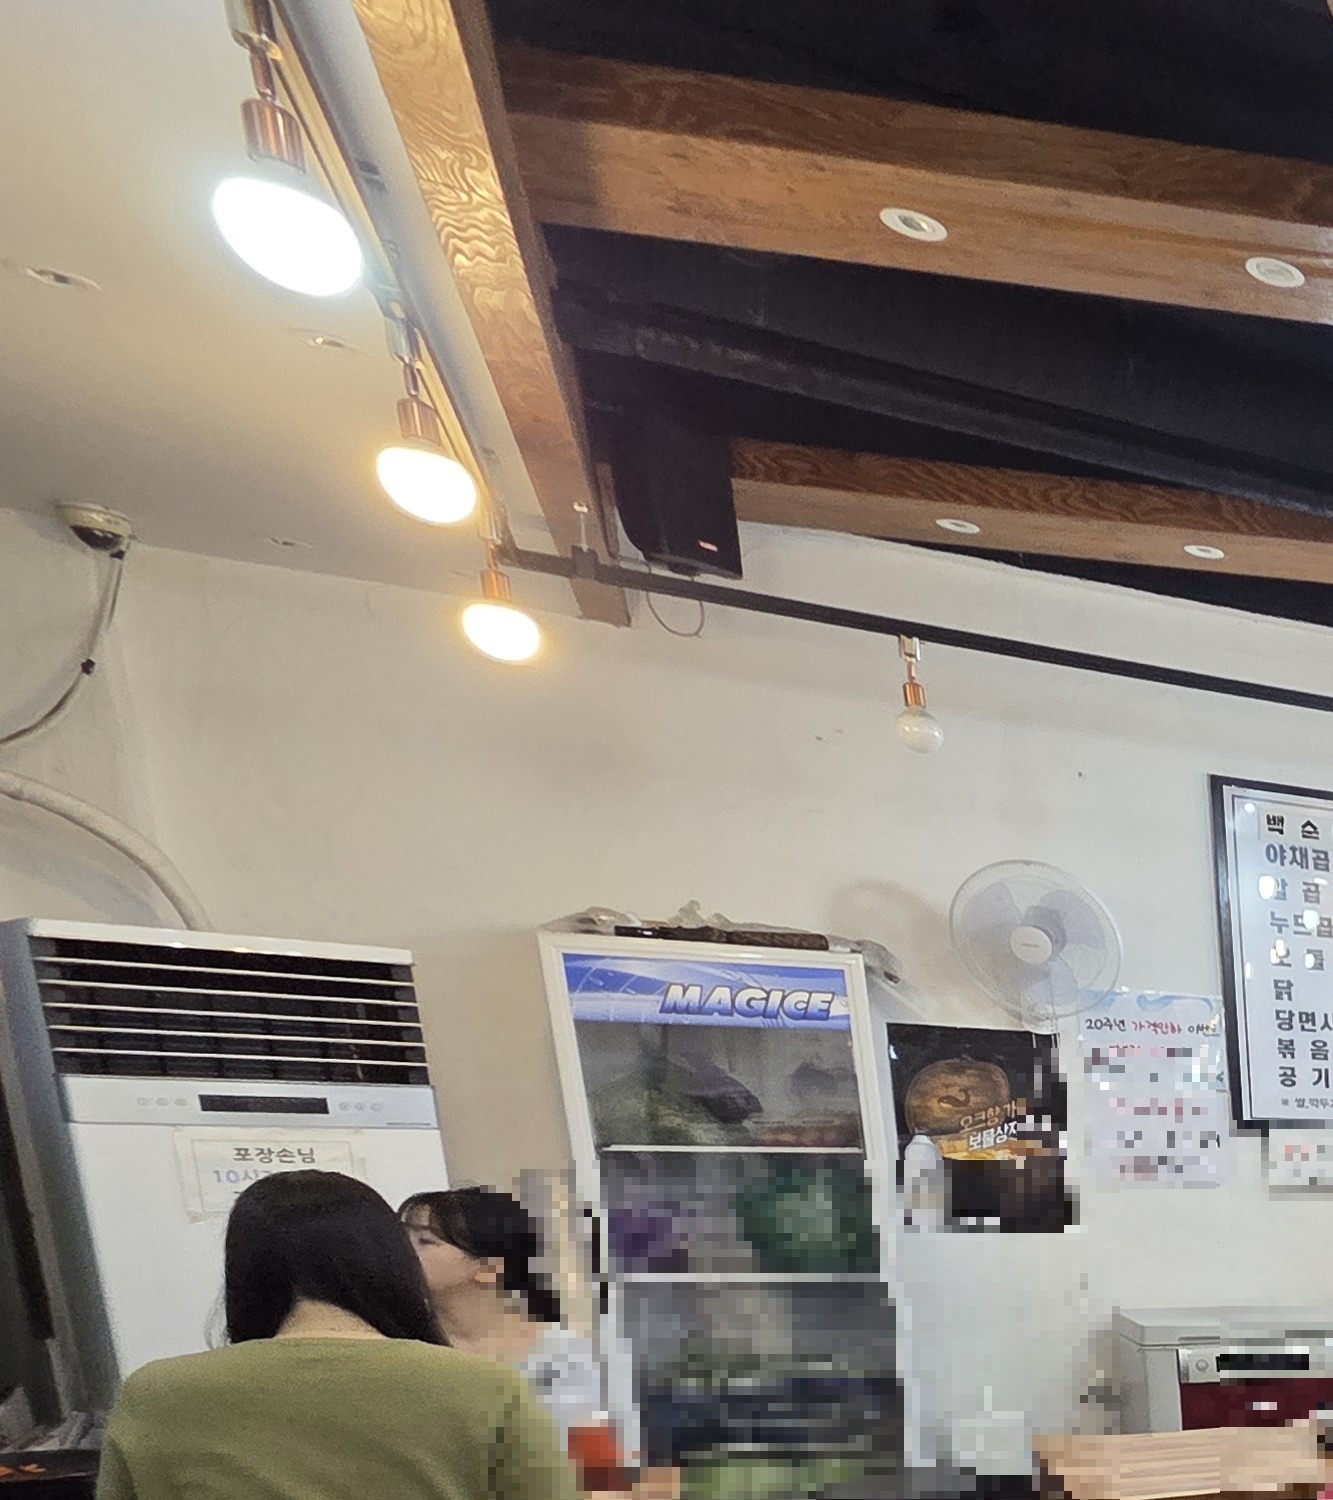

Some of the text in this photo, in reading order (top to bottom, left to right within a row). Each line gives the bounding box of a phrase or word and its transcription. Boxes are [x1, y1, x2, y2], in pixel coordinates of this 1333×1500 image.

[659, 982, 835, 1021] MAGICE
[1085, 1017, 1126, 1032] 20주년
[1131, 1019, 1182, 1035] 가격인하
[233, 1147, 316, 1164] 포장손님
[212, 1169, 272, 1185] 10시
